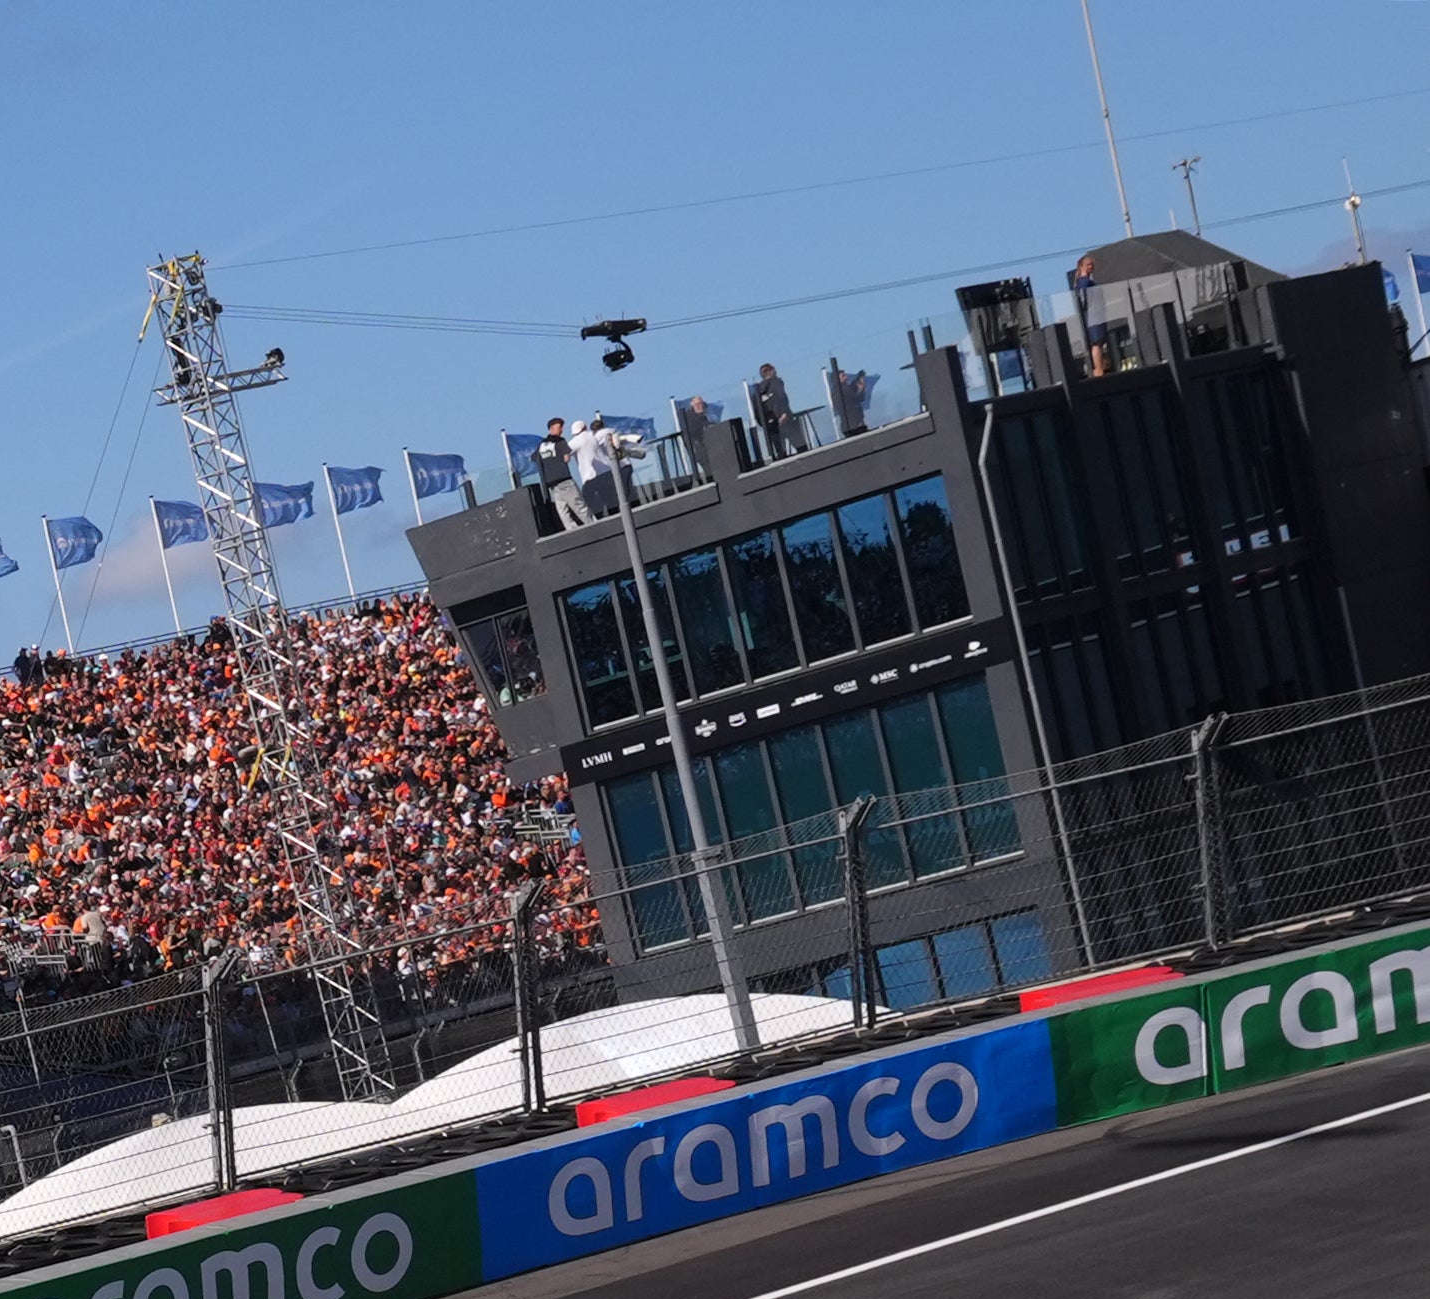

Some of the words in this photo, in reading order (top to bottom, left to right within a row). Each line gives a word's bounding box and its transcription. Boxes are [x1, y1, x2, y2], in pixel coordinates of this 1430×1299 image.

[878, 668, 899, 683] MSC
[834, 679, 858, 693] QATAR
[582, 751, 613, 769] LVMH
[549, 1063, 979, 1236] aramco
